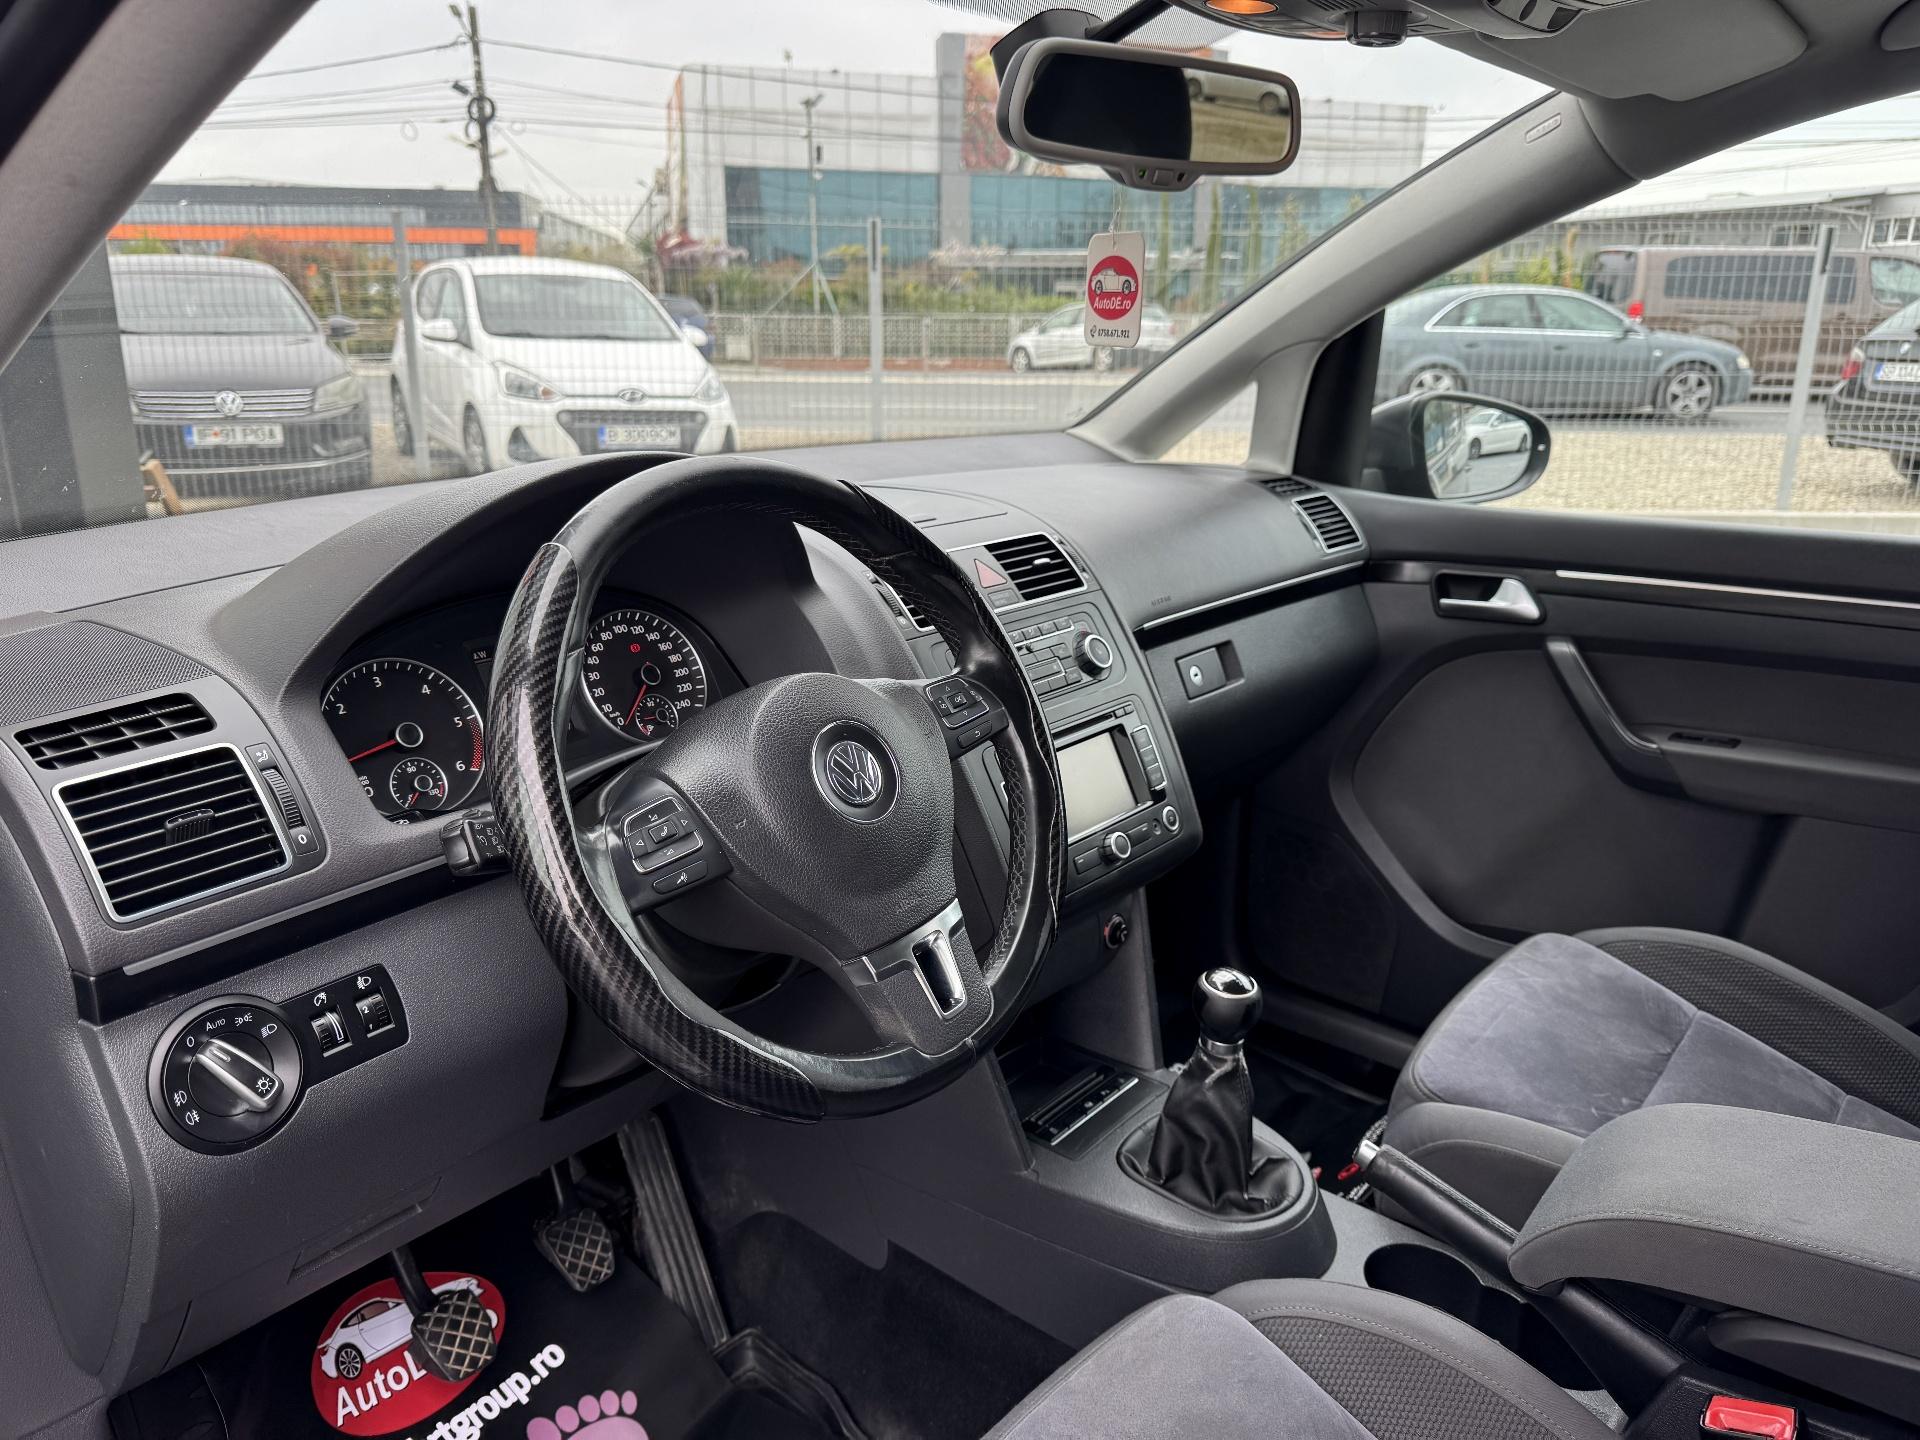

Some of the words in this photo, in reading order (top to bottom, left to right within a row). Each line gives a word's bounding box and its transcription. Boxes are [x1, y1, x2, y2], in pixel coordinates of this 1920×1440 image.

[1093, 296, 1132, 310] AutoDE.ro
[612, 624, 628, 634] 100
[630, 624, 645, 634] 120
[600, 631, 613, 641] 80
[645, 631, 660, 642] 140
[591, 642, 604, 652] 60
[658, 641, 673, 651] 160
[587, 655, 600, 665] 40
[668, 653, 683, 663] 180
[587, 671, 600, 681] 30
[673, 667, 689, 677] 200
[372, 676, 382, 688] 3
[421, 684, 431, 695] 4
[592, 687, 605, 697] 20
[676, 682, 693, 693] 220
[601, 703, 613, 713] 10
[675, 698, 691, 709] 240
[335, 703, 347, 715] 2
[453, 717, 463, 728] 5
[617, 717, 625, 726] 0
[455, 760, 466, 771] 6
[362, 1005, 370, 1014] 2
[186, 1036, 195, 1048] 0
